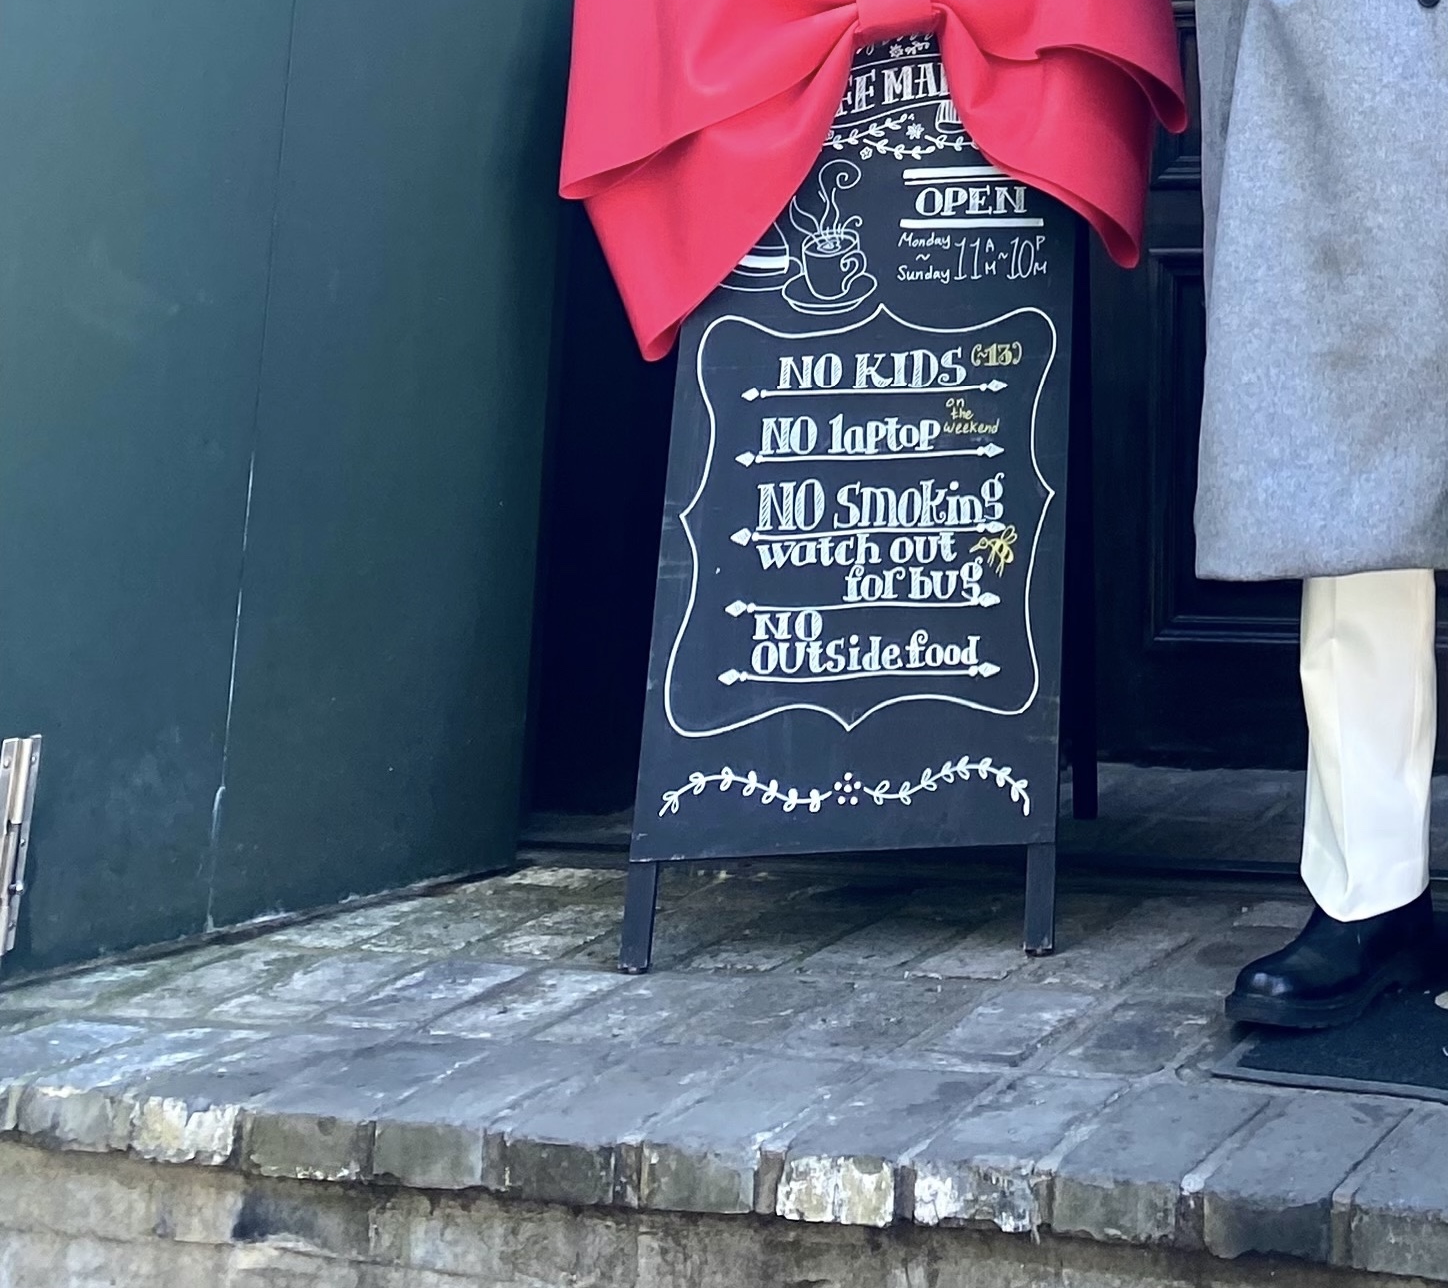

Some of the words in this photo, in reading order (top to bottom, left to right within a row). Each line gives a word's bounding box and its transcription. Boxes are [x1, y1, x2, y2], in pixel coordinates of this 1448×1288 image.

[915, 185, 1028, 216] OPEN
[898, 232, 951, 250] Monday
[897, 265, 951, 284] Sunday
[777, 353, 843, 389] NO
[853, 347, 967, 388] KIDS
[946, 397, 965, 407] on
[950, 407, 974, 419] the
[759, 416, 817, 455] NO
[943, 418, 1000, 434] weekend
[756, 478, 825, 531] NO
[756, 534, 881, 570] watch
[843, 564, 905, 602] for
[752, 610, 823, 641] NO
[905, 629, 981, 668] food
